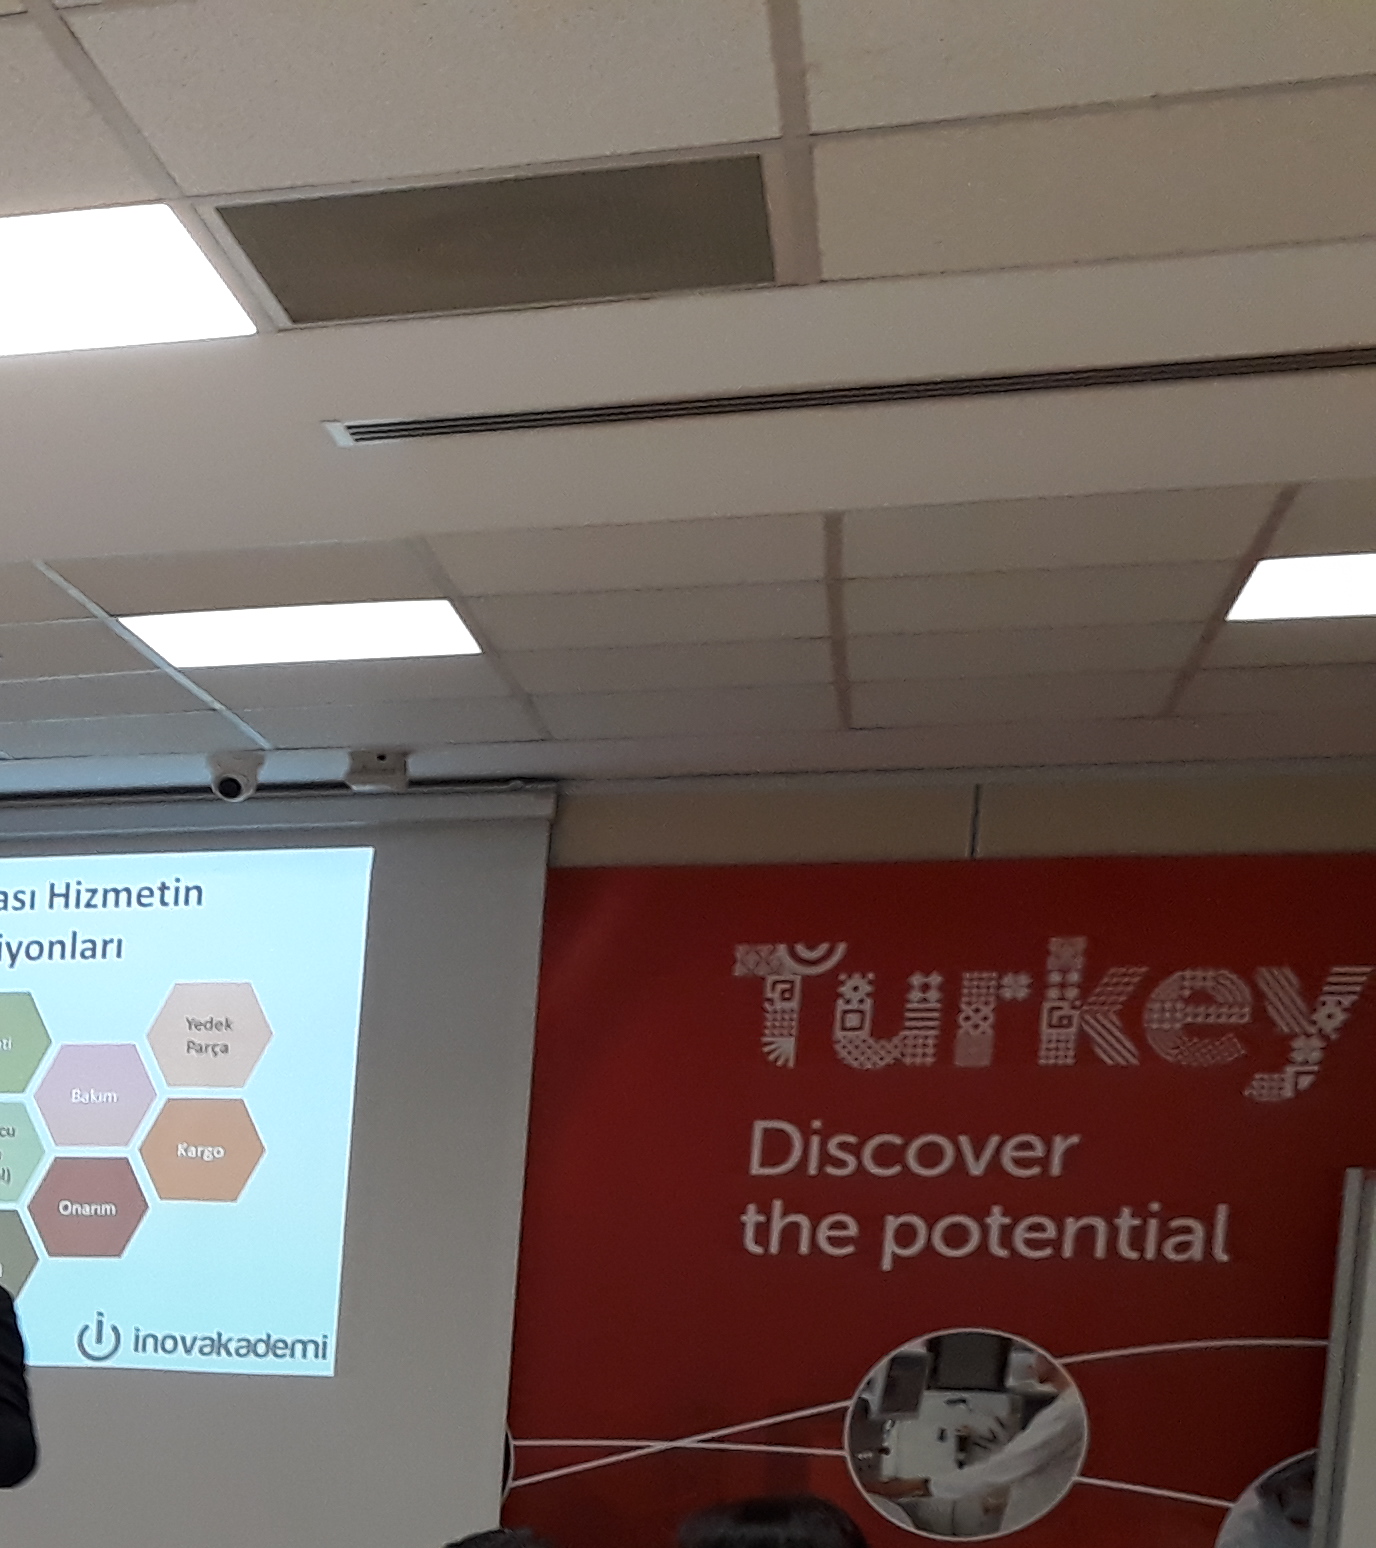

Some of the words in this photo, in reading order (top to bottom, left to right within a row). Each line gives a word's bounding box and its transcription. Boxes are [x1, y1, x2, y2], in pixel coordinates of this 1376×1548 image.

[48, 879, 203, 911] Hizmetin
[185, 1016, 233, 1032] Yedek
[732, 936, 1372, 1100] Turkey
[186, 1041, 230, 1058] Parça
[71, 1088, 119, 1104] Bakım
[177, 1142, 226, 1161] Kargo
[748, 1119, 1082, 1178] Discover
[58, 1200, 117, 1216] Onarım
[740, 1200, 859, 1256] the
[881, 1203, 1230, 1271] potential
[132, 1326, 328, 1362] inovakademi
